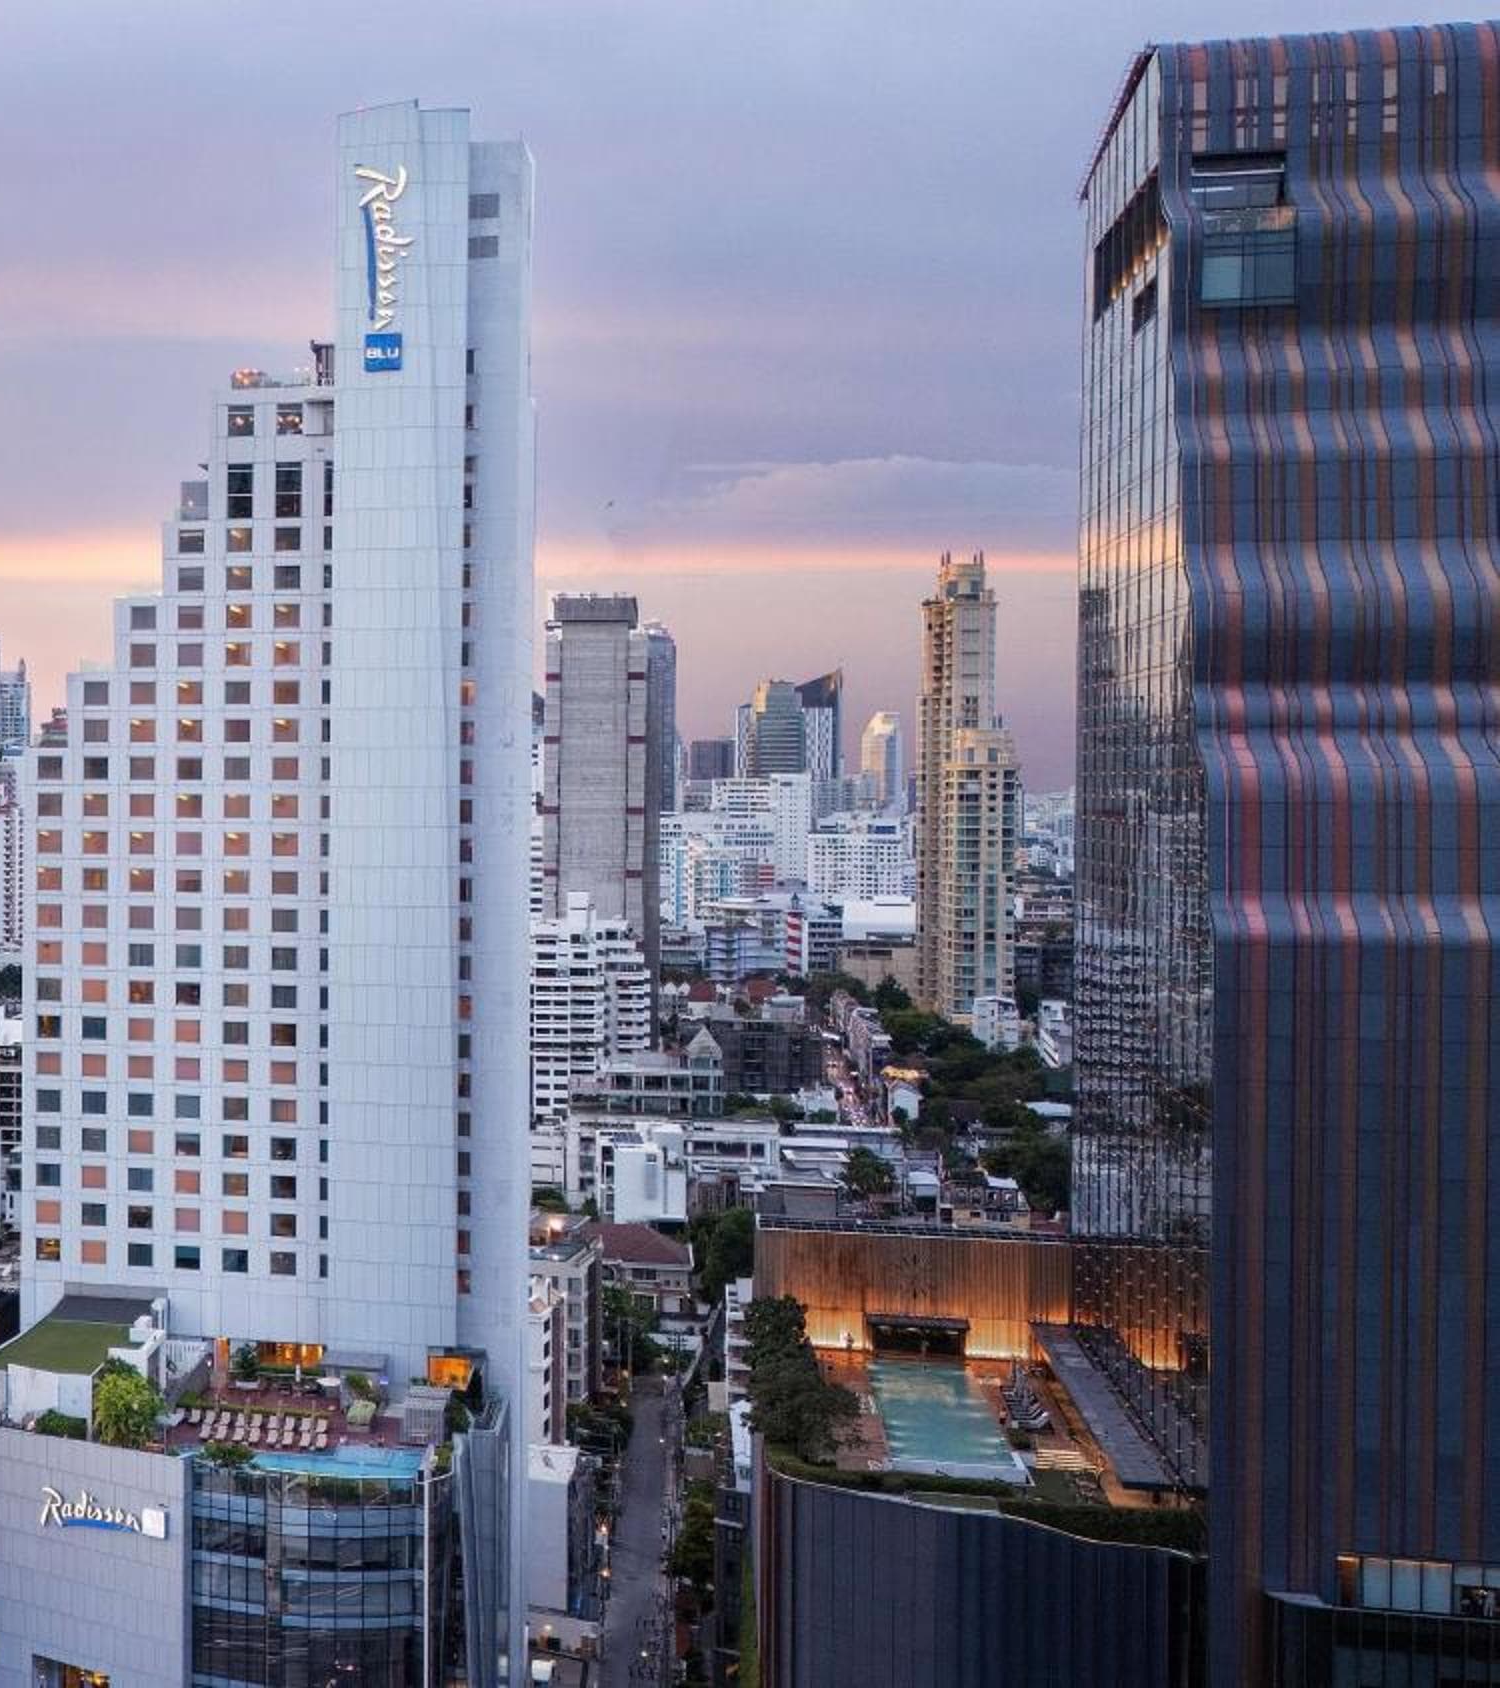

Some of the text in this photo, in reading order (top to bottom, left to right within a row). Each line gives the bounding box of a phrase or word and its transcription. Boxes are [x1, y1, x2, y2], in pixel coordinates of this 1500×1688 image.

[355, 164, 415, 331] Radisson
[366, 346, 399, 359] BLU
[40, 1487, 140, 1532] Radisson
